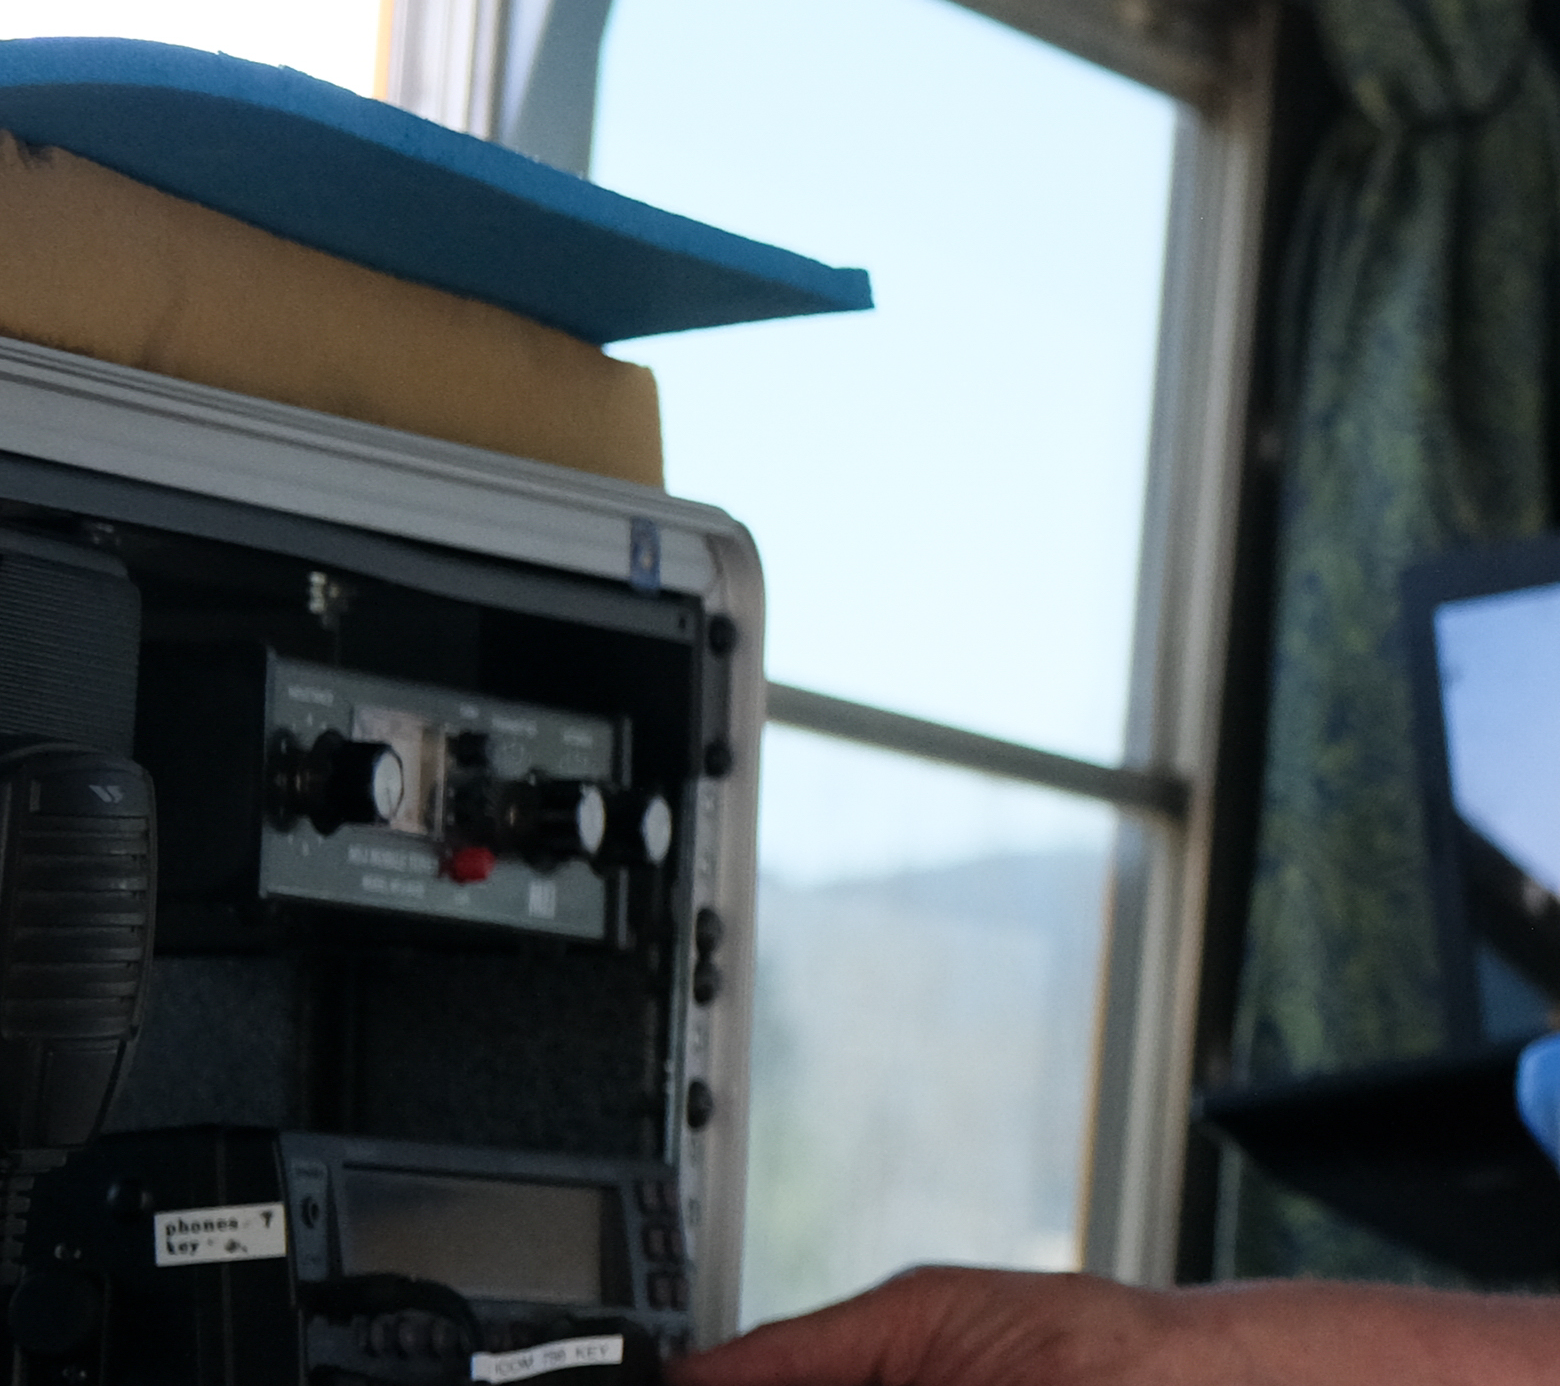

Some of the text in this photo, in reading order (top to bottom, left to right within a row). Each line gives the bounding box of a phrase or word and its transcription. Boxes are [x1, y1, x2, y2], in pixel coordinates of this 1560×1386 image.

[165, 1216, 238, 1237] phones
[165, 1234, 200, 1256] key
[575, 1344, 610, 1359] KEY
